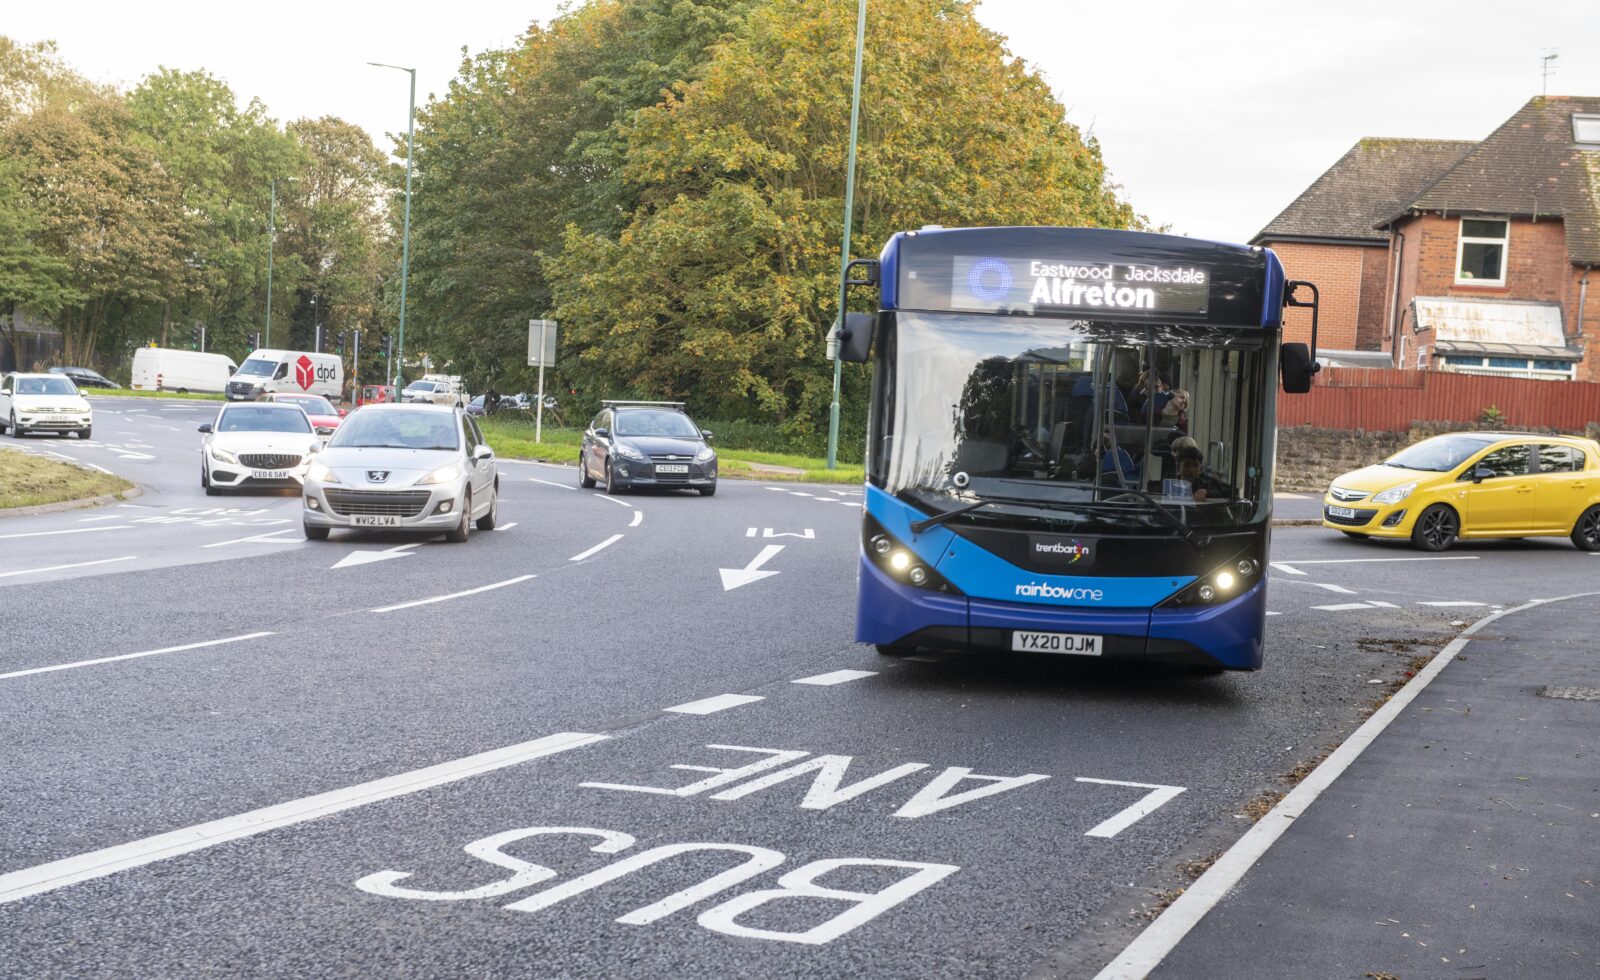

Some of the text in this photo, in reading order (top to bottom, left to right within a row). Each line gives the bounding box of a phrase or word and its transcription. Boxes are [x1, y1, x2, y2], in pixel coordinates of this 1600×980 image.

[1030, 261, 1206, 284] Eastwood Jacksdale
[1029, 278, 1155, 309] Alfreton
[317, 363, 336, 383] dpd
[355, 516, 396, 525] WV12 LVA
[1020, 632, 1061, 651] YX20
[578, 743, 1188, 839] LANE
[355, 825, 960, 946] BUS
